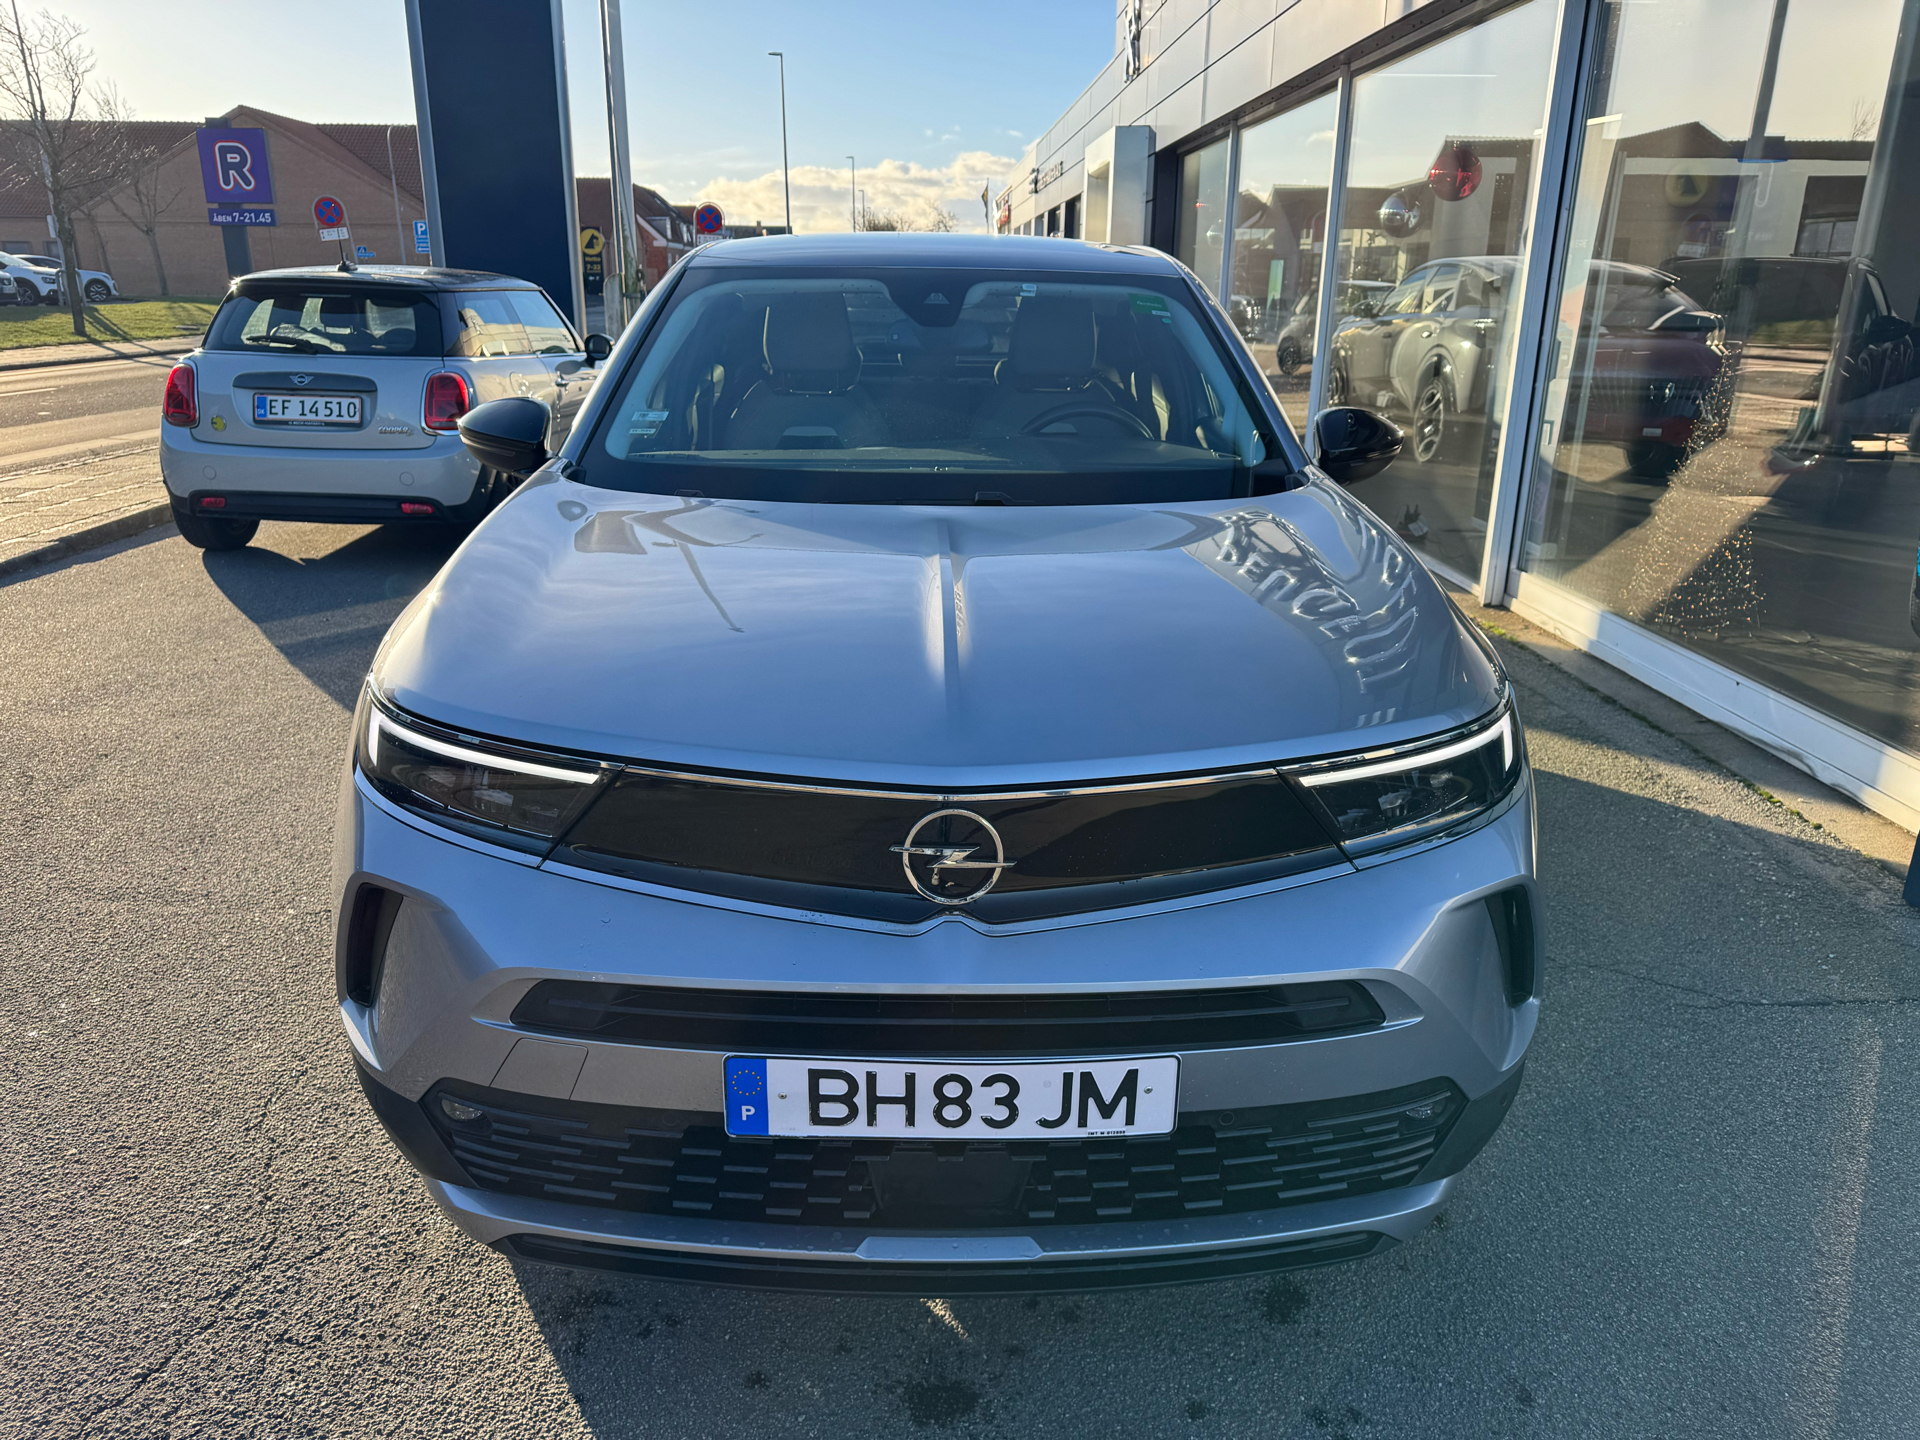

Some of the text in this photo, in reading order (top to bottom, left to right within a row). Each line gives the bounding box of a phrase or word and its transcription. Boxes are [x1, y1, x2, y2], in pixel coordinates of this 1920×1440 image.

[213, 140, 256, 191] R
[213, 212, 271, 223] ÅBEN 7-21.45
[417, 222, 426, 235] P
[269, 399, 291, 416] EF
[807, 1067, 1139, 1129] BH 83 JM
[741, 1105, 756, 1121] P
